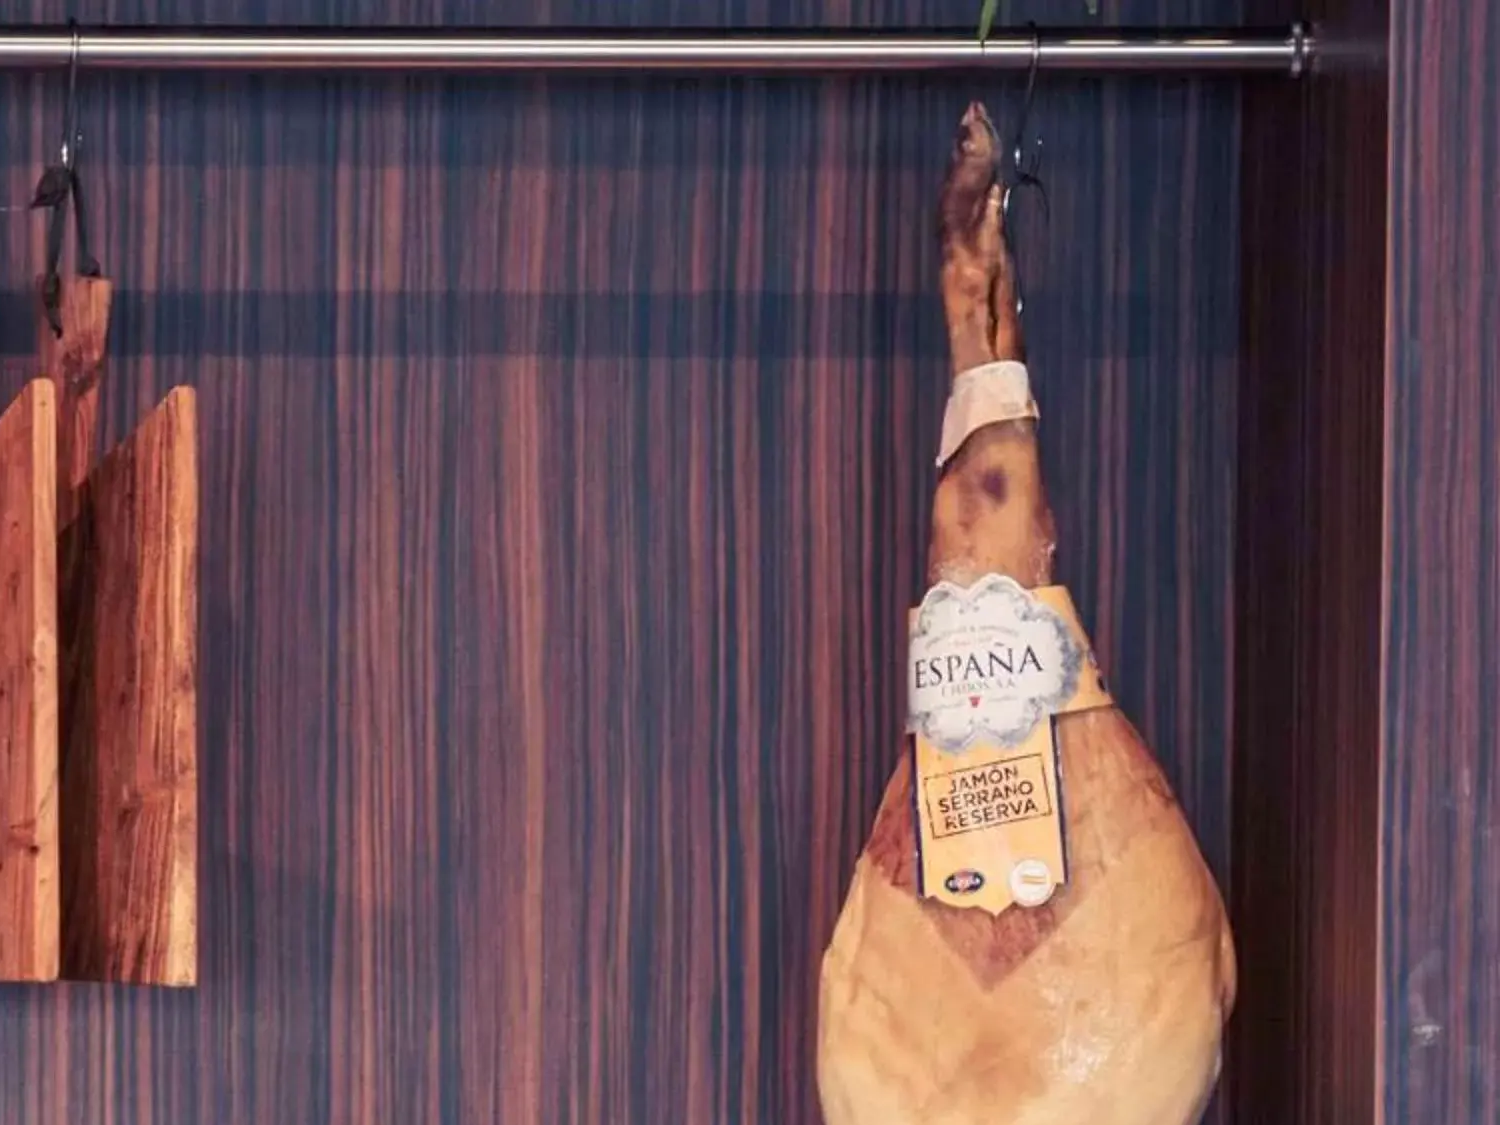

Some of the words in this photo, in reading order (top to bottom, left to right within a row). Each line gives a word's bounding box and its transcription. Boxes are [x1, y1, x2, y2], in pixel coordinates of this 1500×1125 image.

[915, 642, 1044, 689] ESPAÑA
[948, 764, 1018, 794] JAMÓN
[938, 780, 1034, 813] SERRANO
[944, 799, 1038, 830] RESERVA
